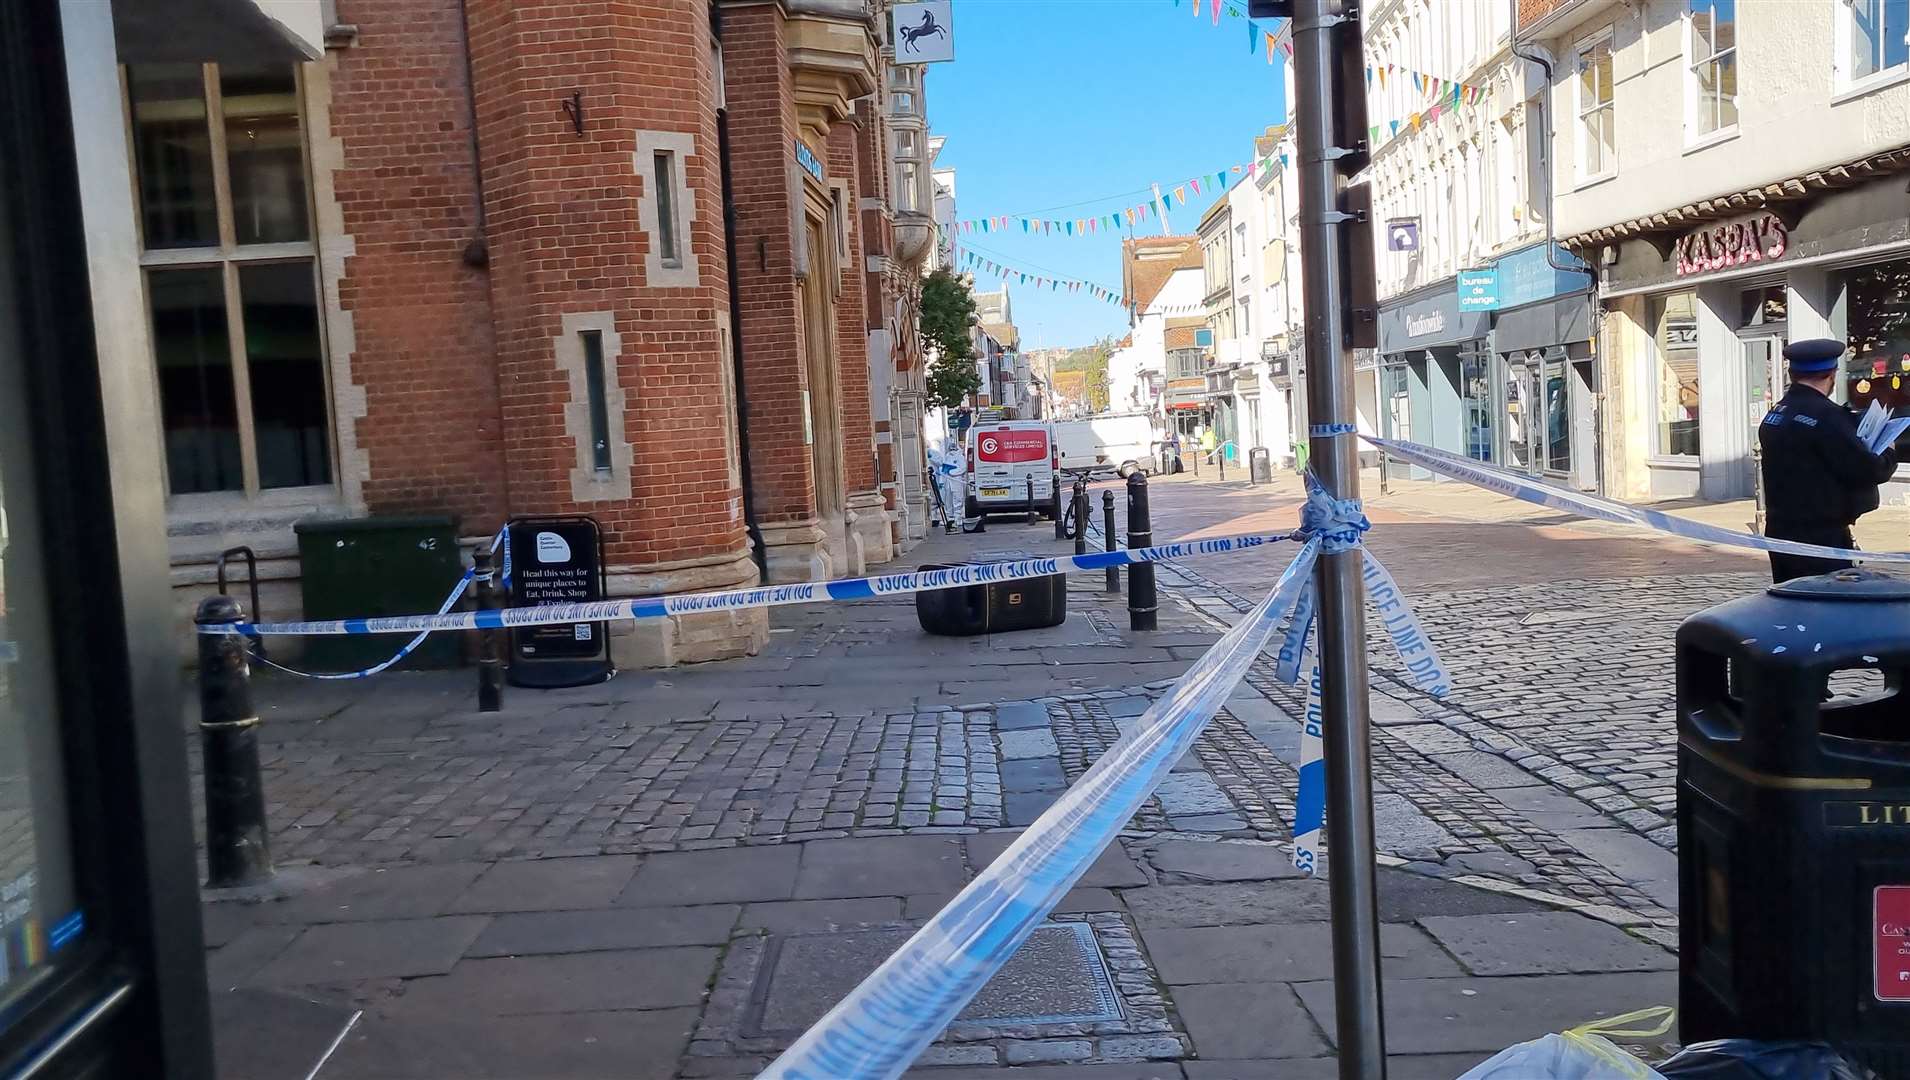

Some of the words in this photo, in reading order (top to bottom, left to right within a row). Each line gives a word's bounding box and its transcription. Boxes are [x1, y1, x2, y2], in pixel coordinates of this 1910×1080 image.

[1676, 214, 1787, 275] KASPA'S
[1462, 277, 1494, 286] bureau
[1472, 286, 1484, 295] de
[1462, 296, 1495, 305] change
[523, 569, 542, 577] Head
[544, 569, 559, 577] this
[560, 570, 574, 578] way
[577, 568, 588, 576] for
[952, 568, 969, 583] DO
[525, 580, 552, 588] unique
[553, 579, 577, 588] places
[877, 576, 918, 592] CROSS
[923, 571, 948, 587] NOT
[526, 590, 540, 598] Eat,
[542, 590, 566, 598] Drink,
[567, 589, 587, 598] Shop
[1385, 614, 1426, 657] LINE
